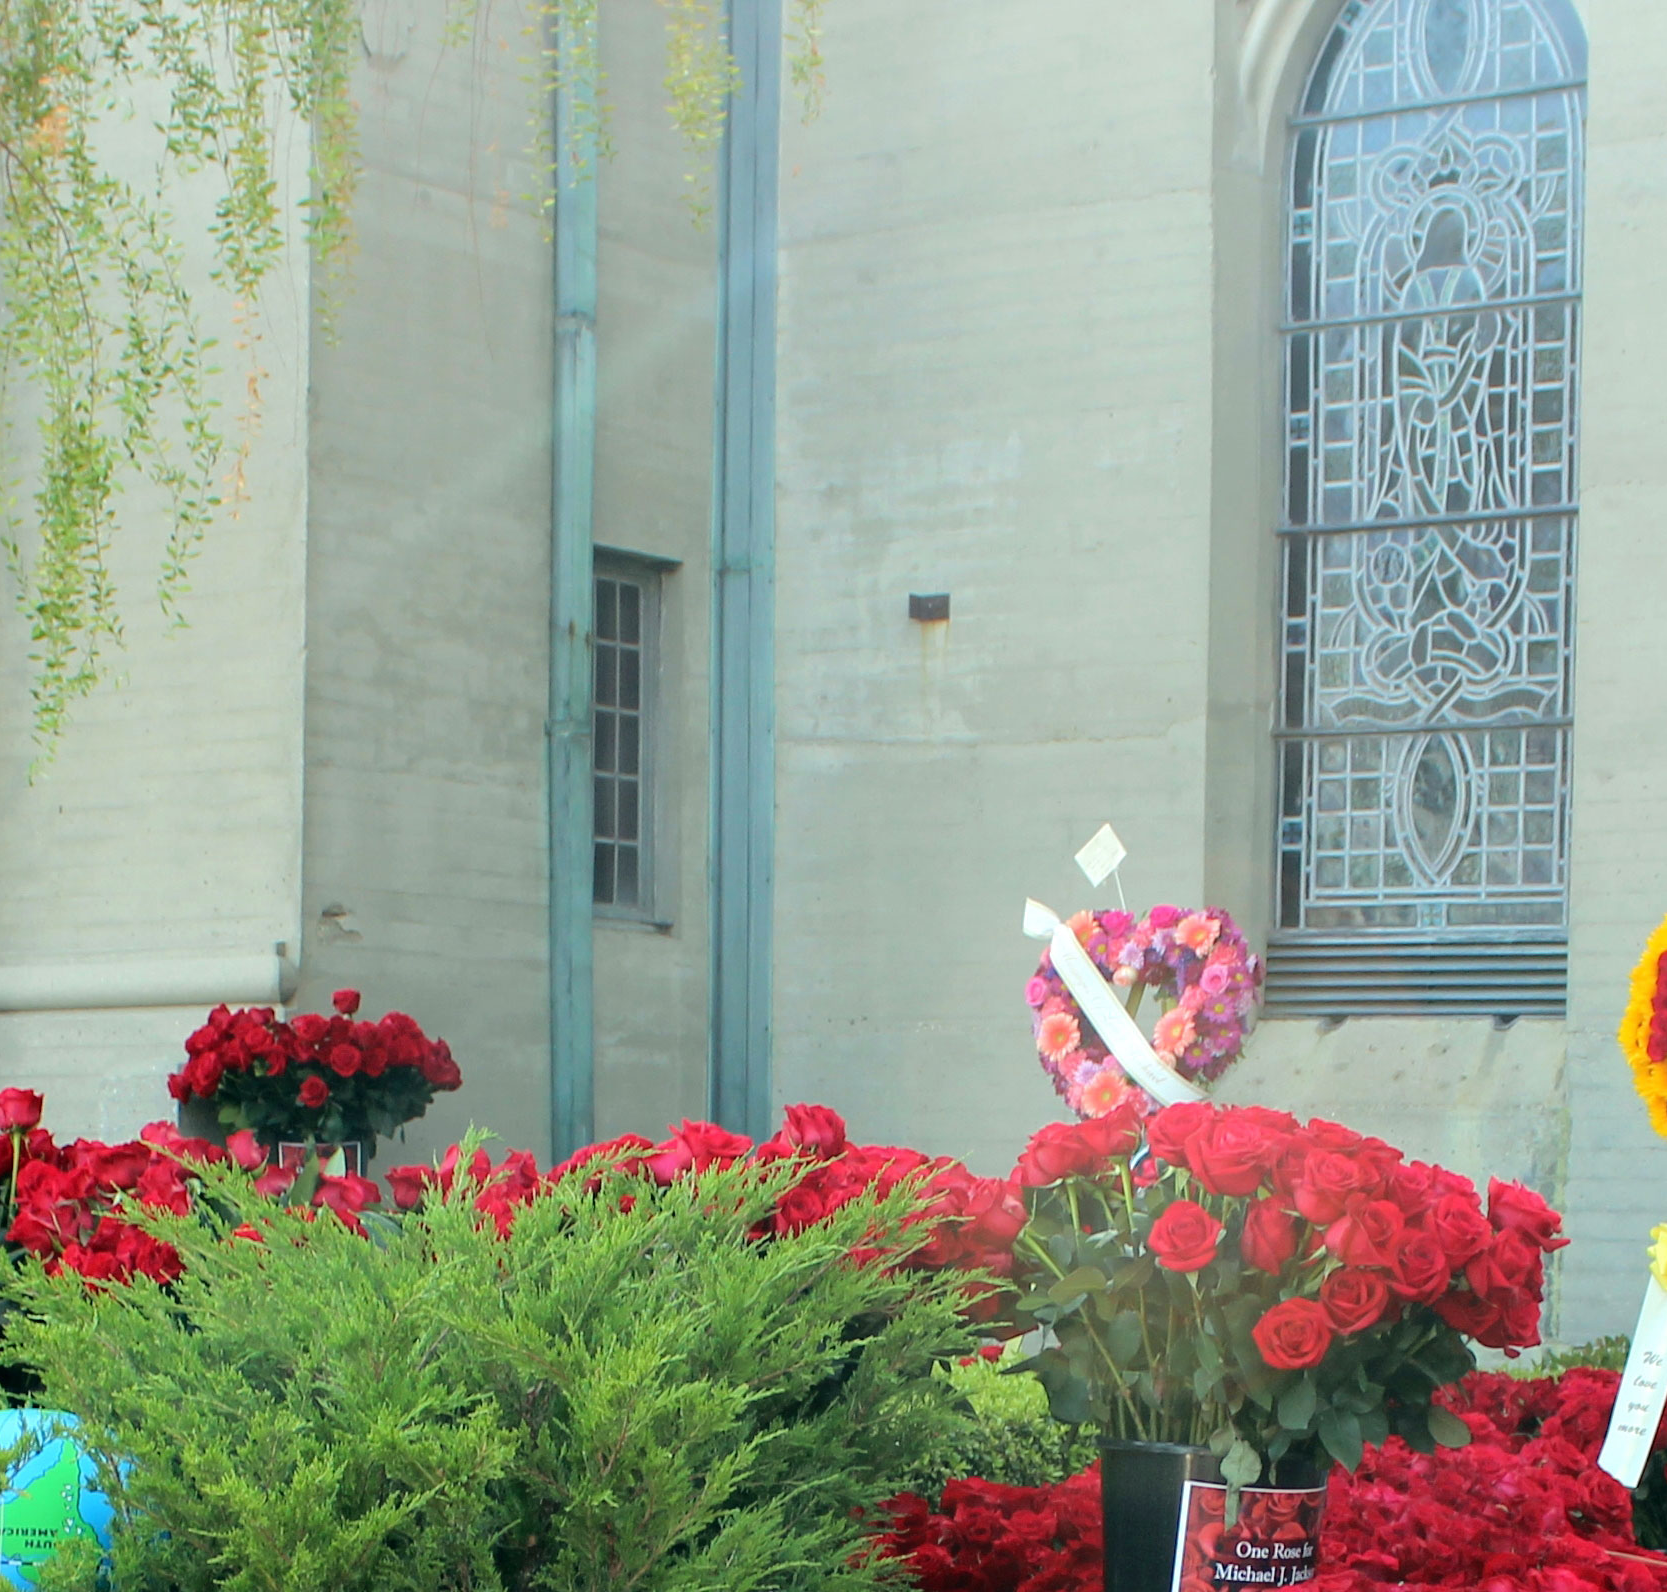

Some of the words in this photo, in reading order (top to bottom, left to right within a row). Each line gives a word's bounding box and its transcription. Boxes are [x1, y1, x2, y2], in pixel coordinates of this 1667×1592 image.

[1642, 1351, 1663, 1366] We
[1633, 1375, 1658, 1389] love
[1627, 1402, 1650, 1413] you
[1617, 1424, 1647, 1436] more
[24, 1539, 57, 1549] UTH
[1236, 1541, 1269, 1559] One
[1272, 1542, 1301, 1559] Rose
[1214, 1563, 1275, 1583] Michael
[1277, 1566, 1287, 1587] J.
